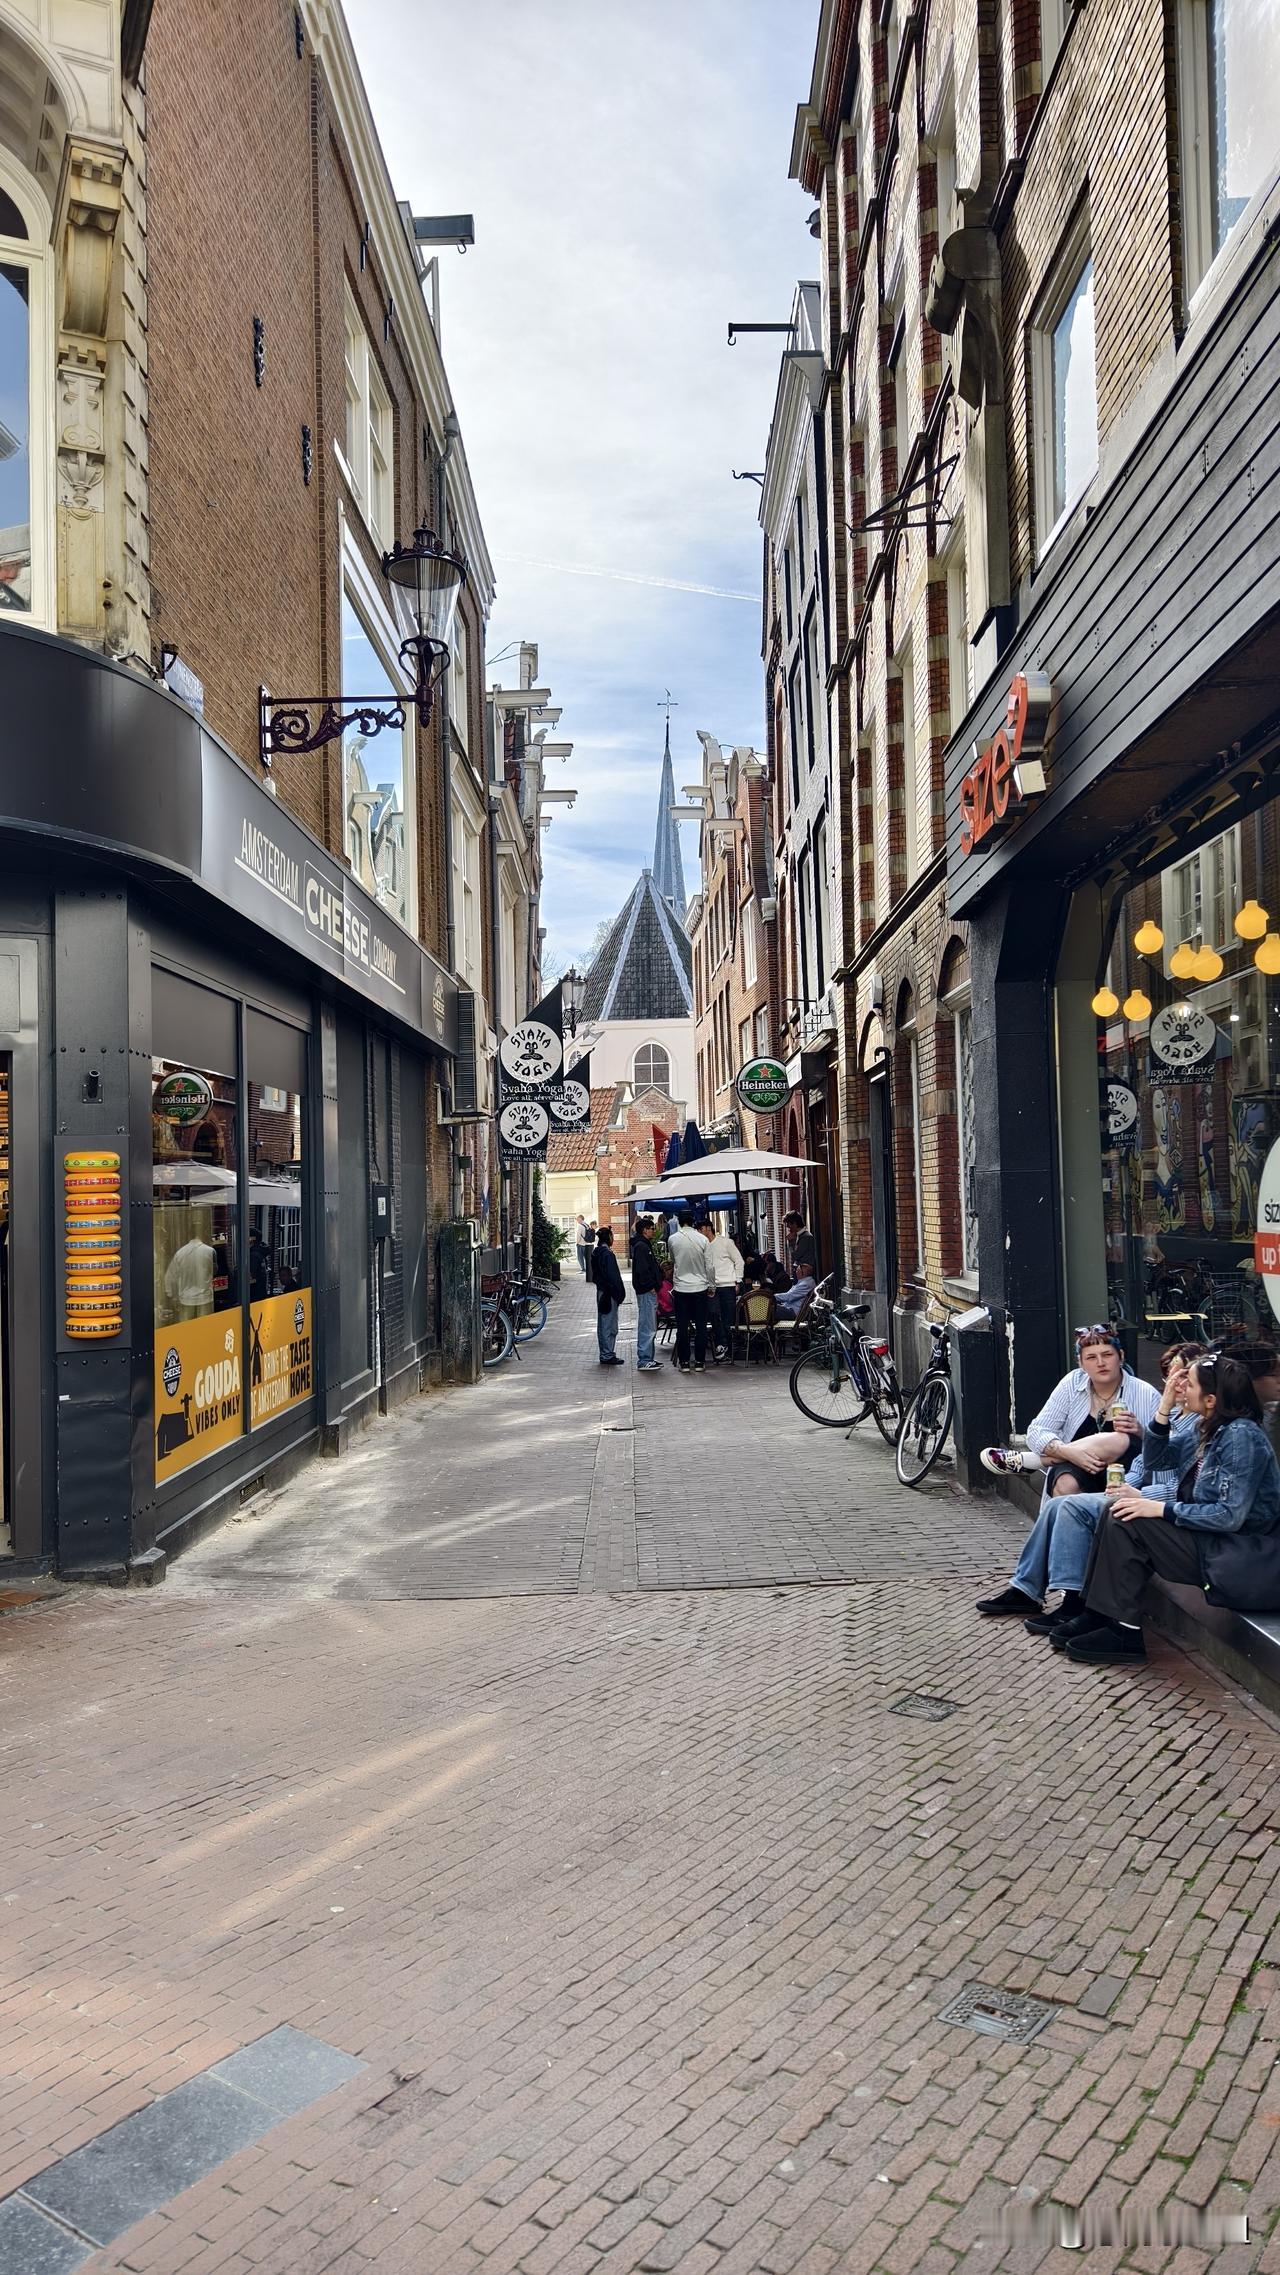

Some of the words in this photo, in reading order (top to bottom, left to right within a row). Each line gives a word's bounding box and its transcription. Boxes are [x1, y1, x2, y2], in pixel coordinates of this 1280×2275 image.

[241, 818, 299, 904] AMSTERDAM
[306, 878, 369, 966] CHEESE
[373, 935, 397, 981] COMPANY
[510, 1028, 552, 1049] SVAHA
[511, 1060, 552, 1077] YOGA
[501, 1083, 534, 1094] Svaha
[537, 1083, 563, 1096] Yoga
[508, 1105, 541, 1122] SVAHA
[556, 1105, 583, 1117] YOGA
[507, 1128, 540, 1143] YOGA
[1265, 1199, 1280, 1223] siz
[1262, 1247, 1277, 1271] up
[290, 1335, 310, 1369] TASTE
[163, 1364, 181, 1381] CHEESE
[195, 1355, 240, 1409] GOUDA
[290, 1364, 311, 1399] HOME
[195, 1404, 219, 1435] VIBES
[221, 1394, 240, 1422] ONLY
